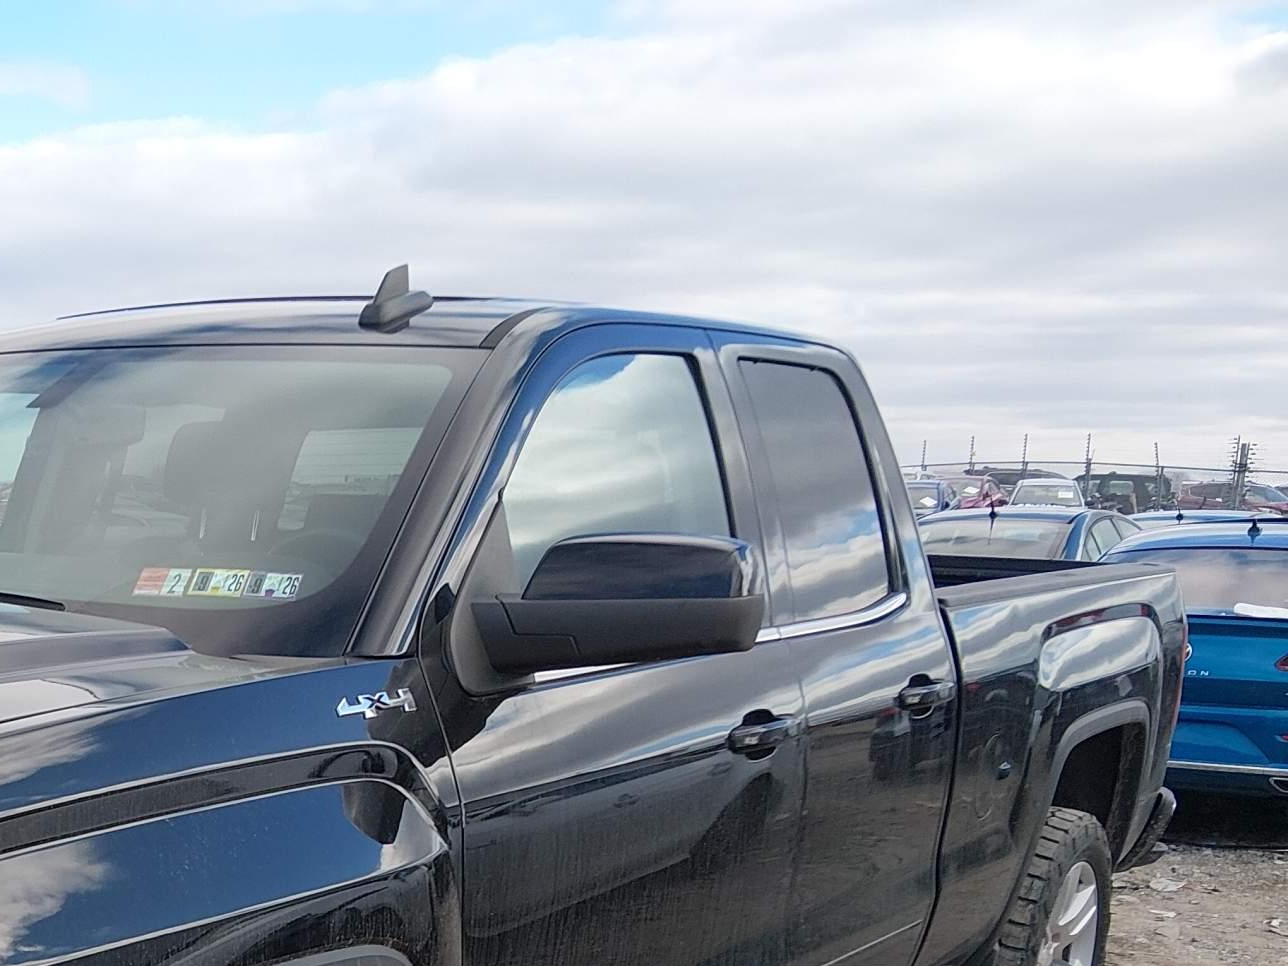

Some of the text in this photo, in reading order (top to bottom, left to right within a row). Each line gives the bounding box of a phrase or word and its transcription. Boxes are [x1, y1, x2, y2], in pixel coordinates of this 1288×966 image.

[167, 573, 182, 594] 2
[227, 573, 243, 592] 26
[281, 574, 300, 595] 26
